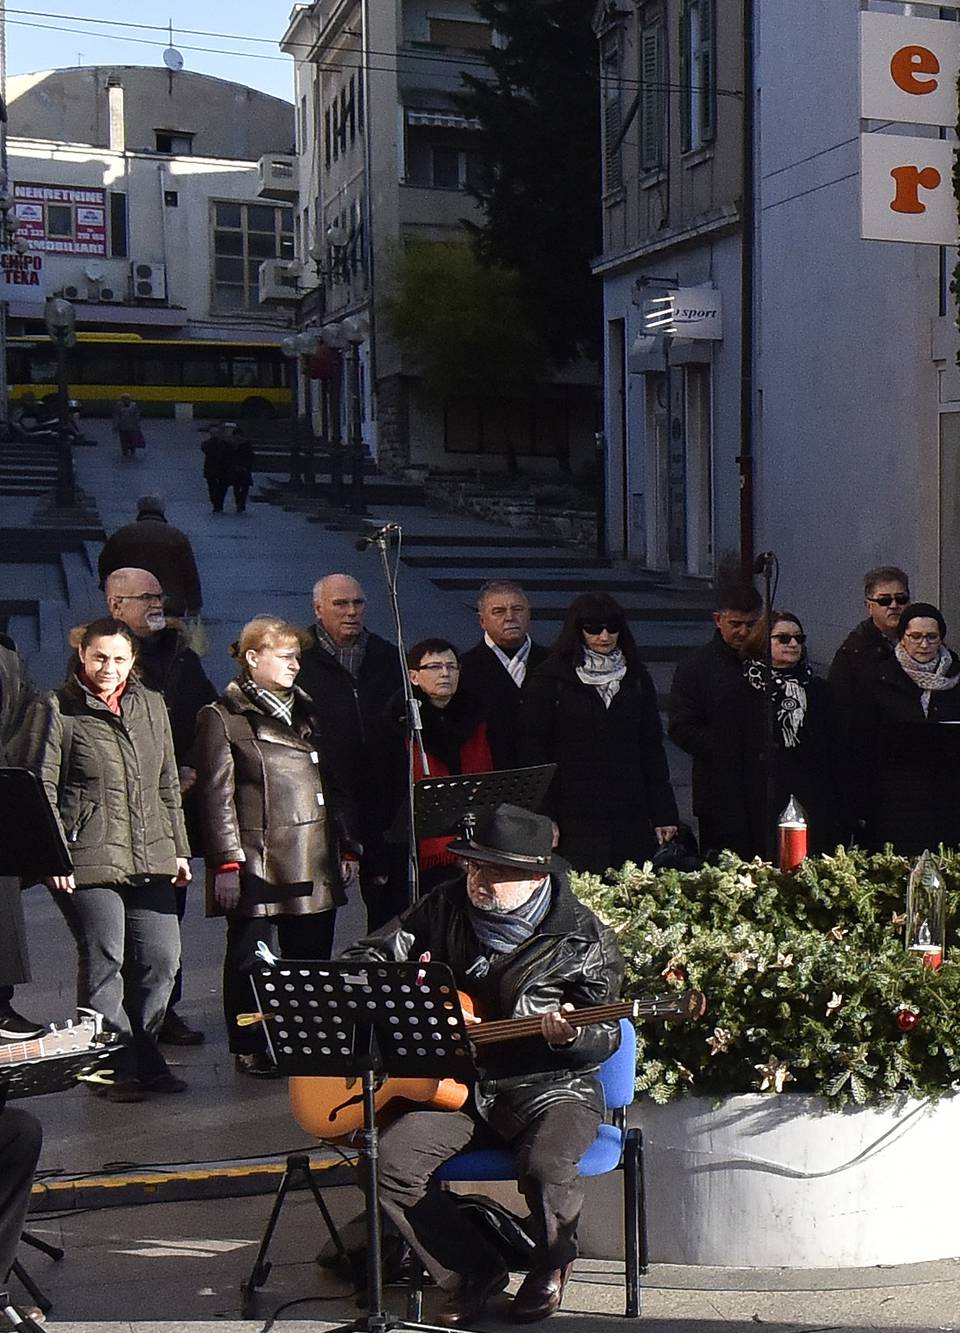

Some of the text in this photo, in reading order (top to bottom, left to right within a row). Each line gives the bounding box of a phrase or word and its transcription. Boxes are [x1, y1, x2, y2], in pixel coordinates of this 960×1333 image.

[15, 186, 103, 203] NEKRETNINE
[27, 240, 104, 254] MOBILIARE
[4, 270, 40, 286] TEKA
